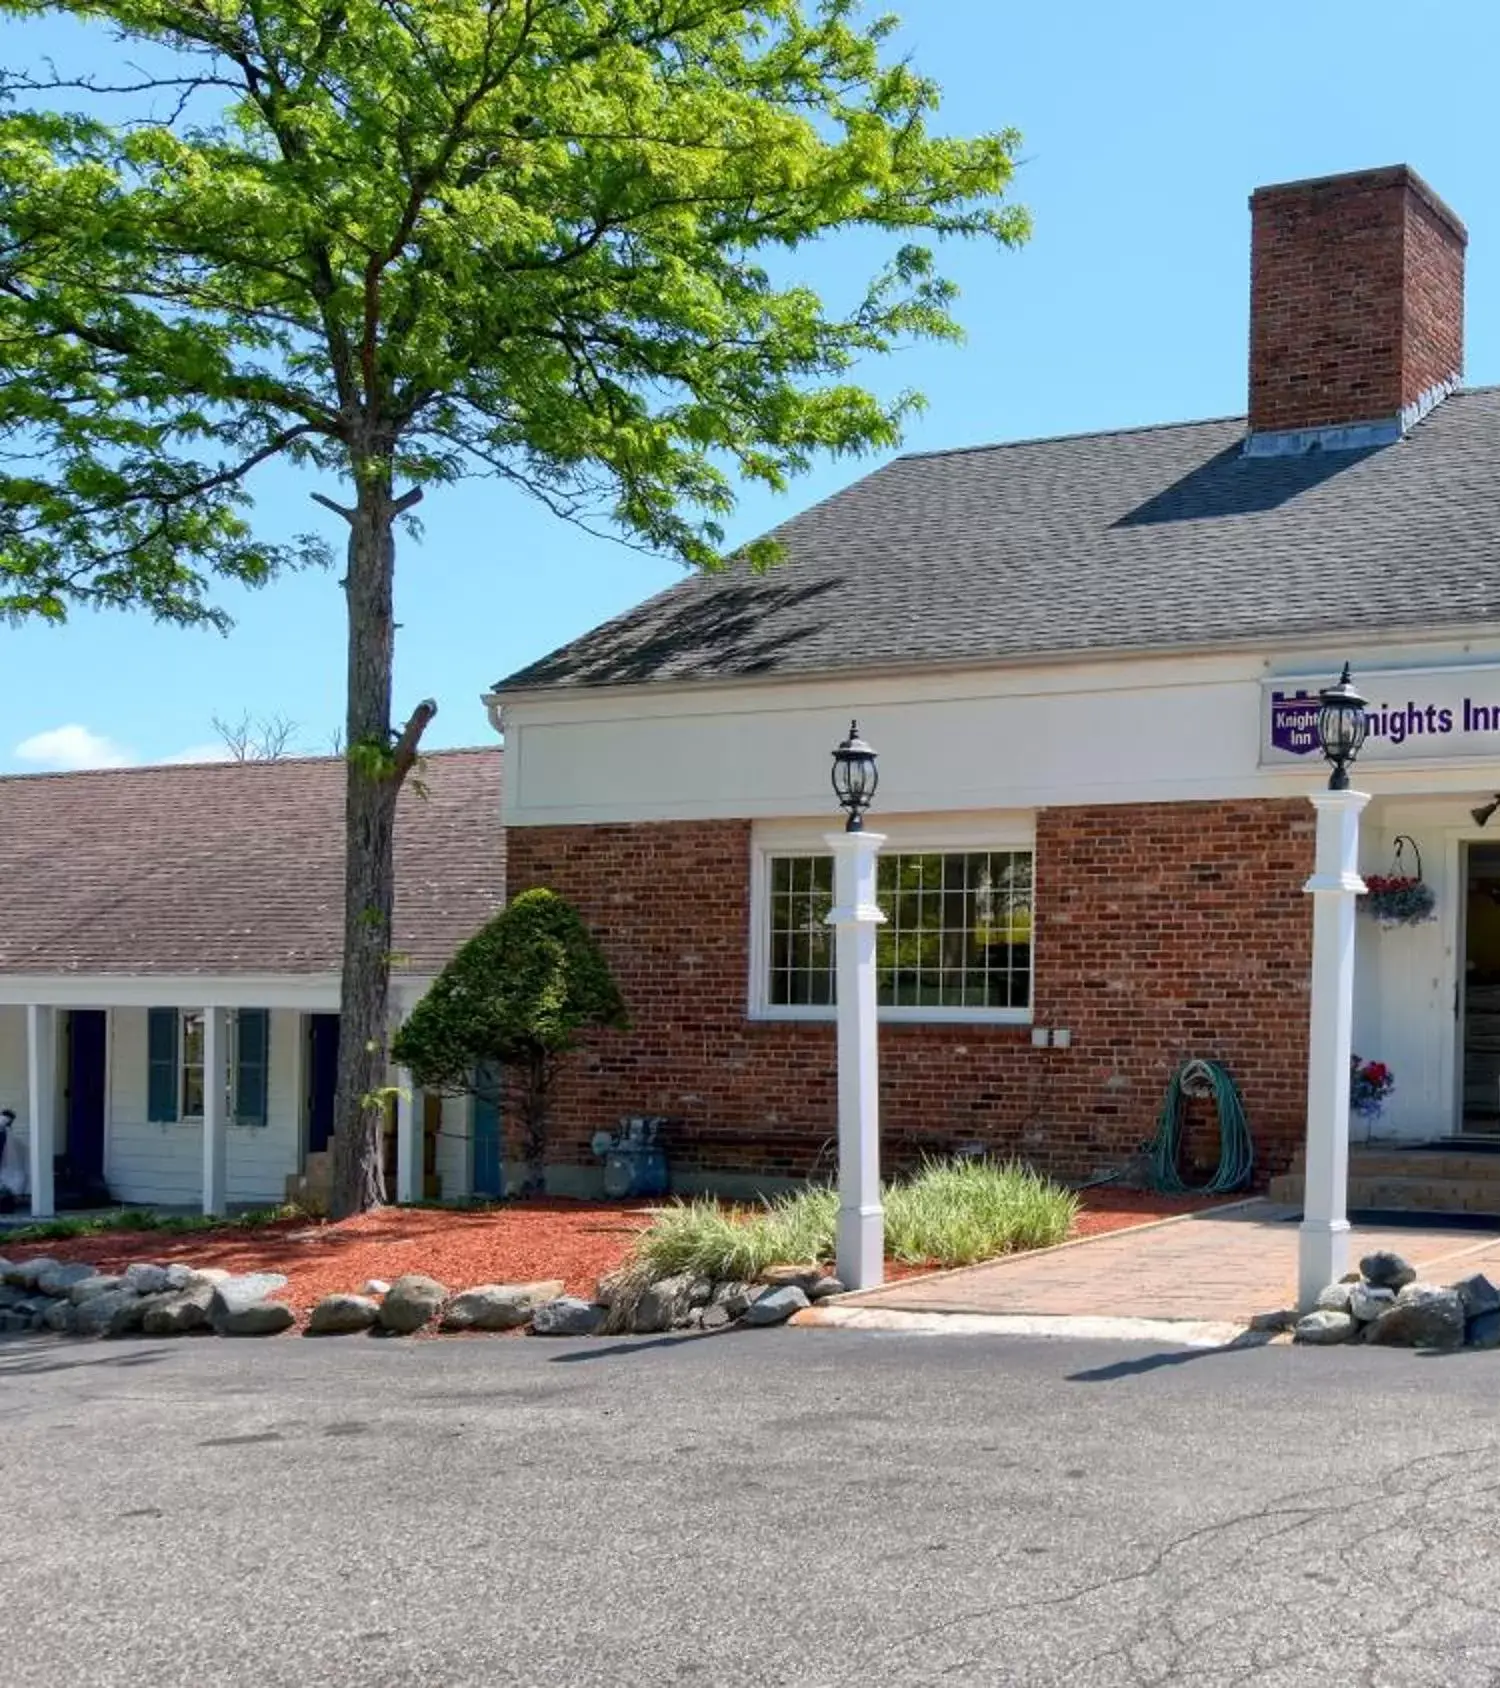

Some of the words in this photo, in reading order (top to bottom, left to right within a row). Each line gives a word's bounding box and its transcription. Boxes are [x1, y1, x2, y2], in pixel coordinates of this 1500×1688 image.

[1275, 711, 1320, 731] Knight
[1361, 701, 1453, 745] nights
[1290, 729, 1312, 746] Inn
